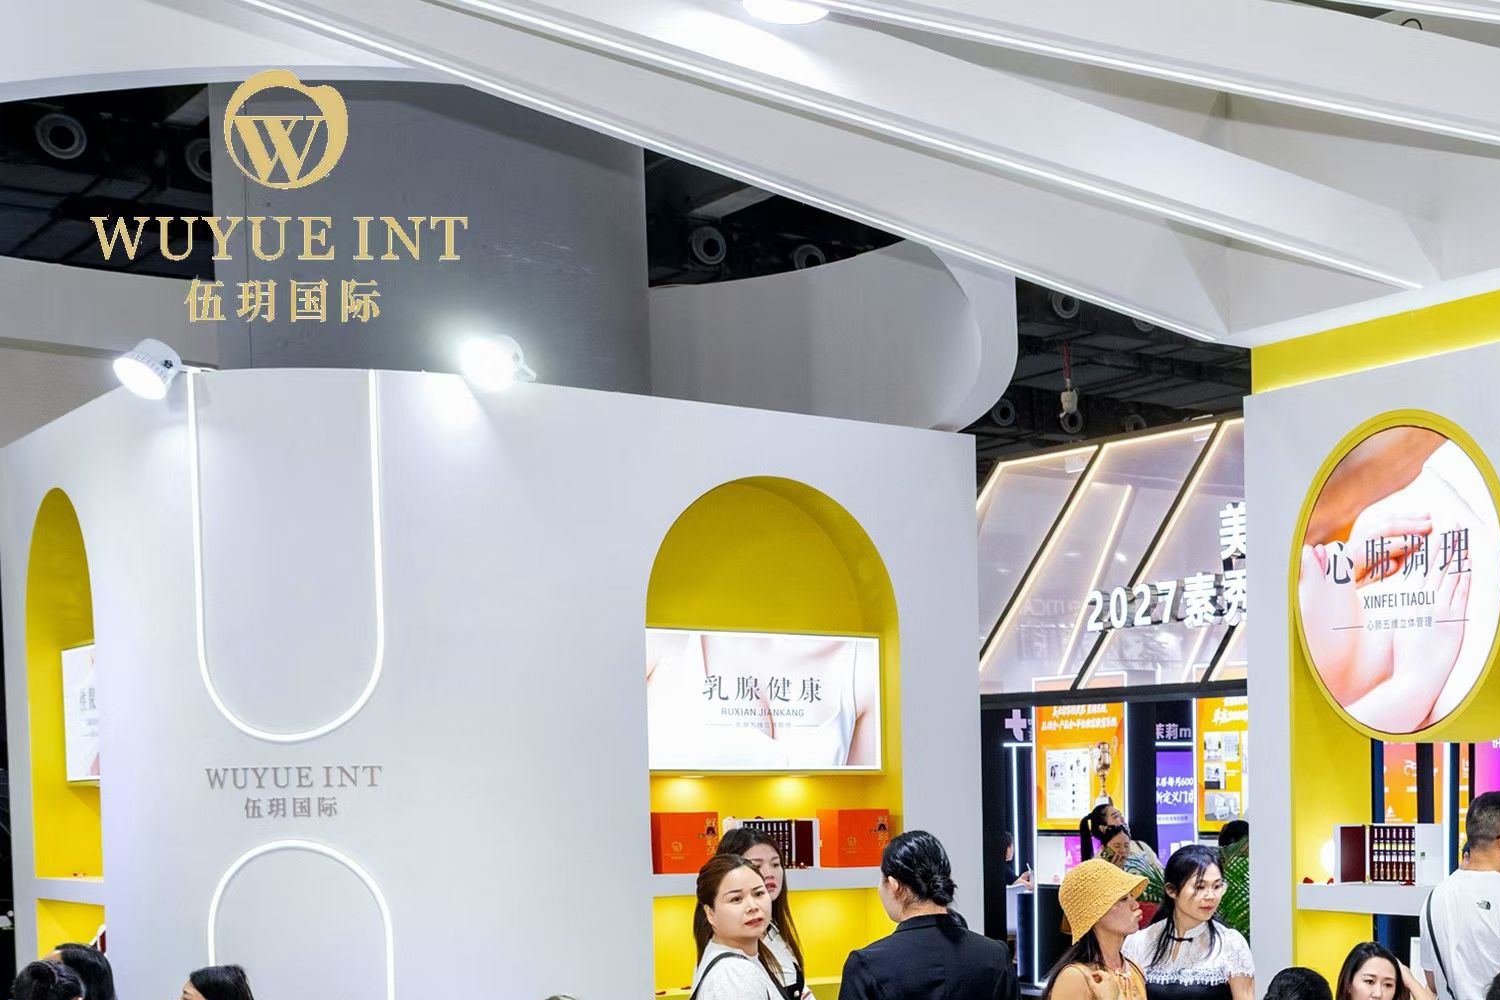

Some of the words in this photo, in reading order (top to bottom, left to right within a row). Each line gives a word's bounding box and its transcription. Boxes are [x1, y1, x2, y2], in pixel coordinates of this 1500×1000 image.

[1325, 527, 1472, 585] 心肺调理
[1363, 591, 1398, 609] XINFEI
[1400, 590, 1435, 607] TIAOLI
[1366, 616, 1433, 632] 心肺五维立体管理
[702, 674, 822, 703] 乳腺健康
[721, 707, 757, 717] RUXIAN
[758, 708, 805, 718] JIANKANG
[205, 767, 314, 790] WUYUE
[322, 765, 382, 788] INT
[244, 796, 338, 819] 伍玥国际
